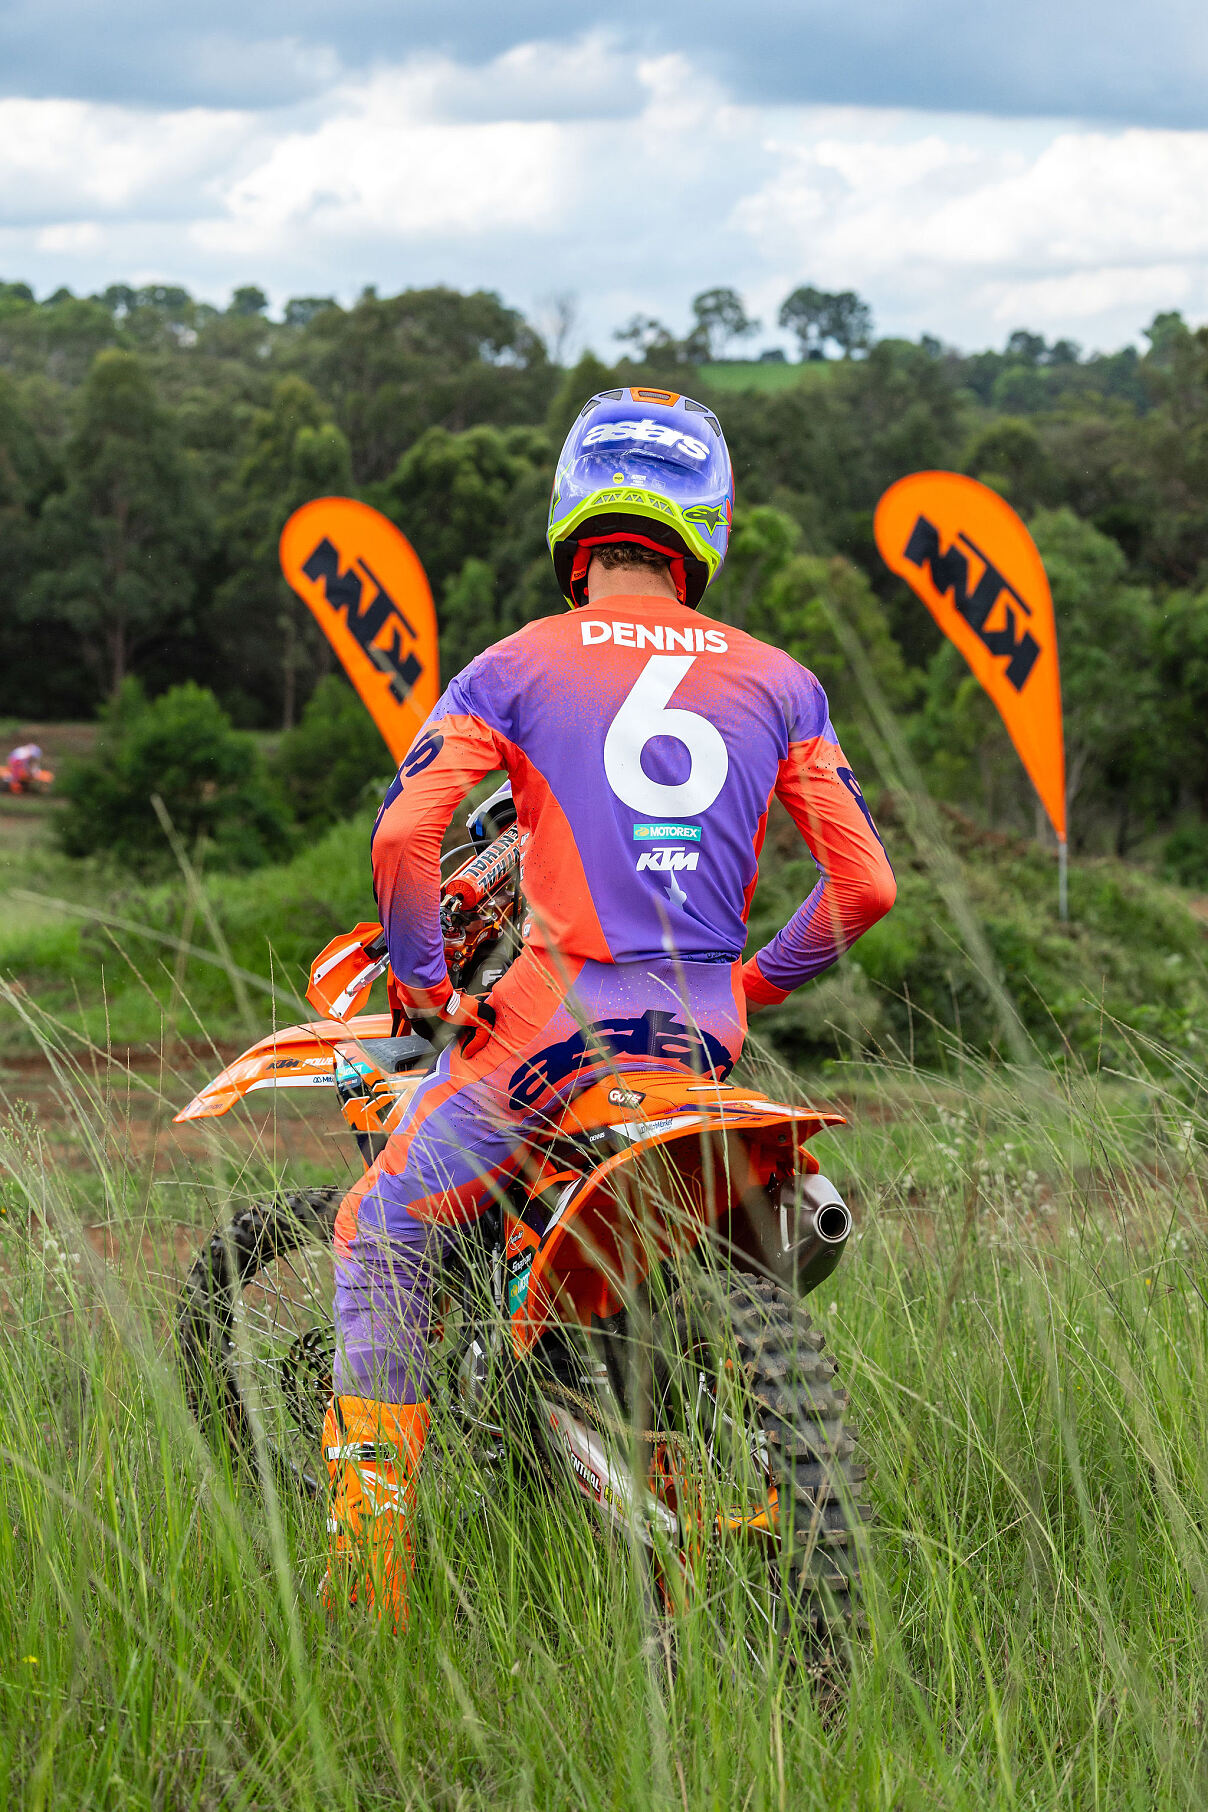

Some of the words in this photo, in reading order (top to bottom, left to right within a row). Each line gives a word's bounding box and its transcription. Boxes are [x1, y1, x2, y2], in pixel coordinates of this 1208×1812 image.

[582, 419, 711, 460] astars
[581, 620, 729, 654] DENNIS
[603, 654, 729, 818] 6
[649, 826, 698, 838] MOTOREX
[636, 846, 700, 871] KTM
[266, 1058, 300, 1070] KTM
[302, 1056, 333, 1068] POWE
